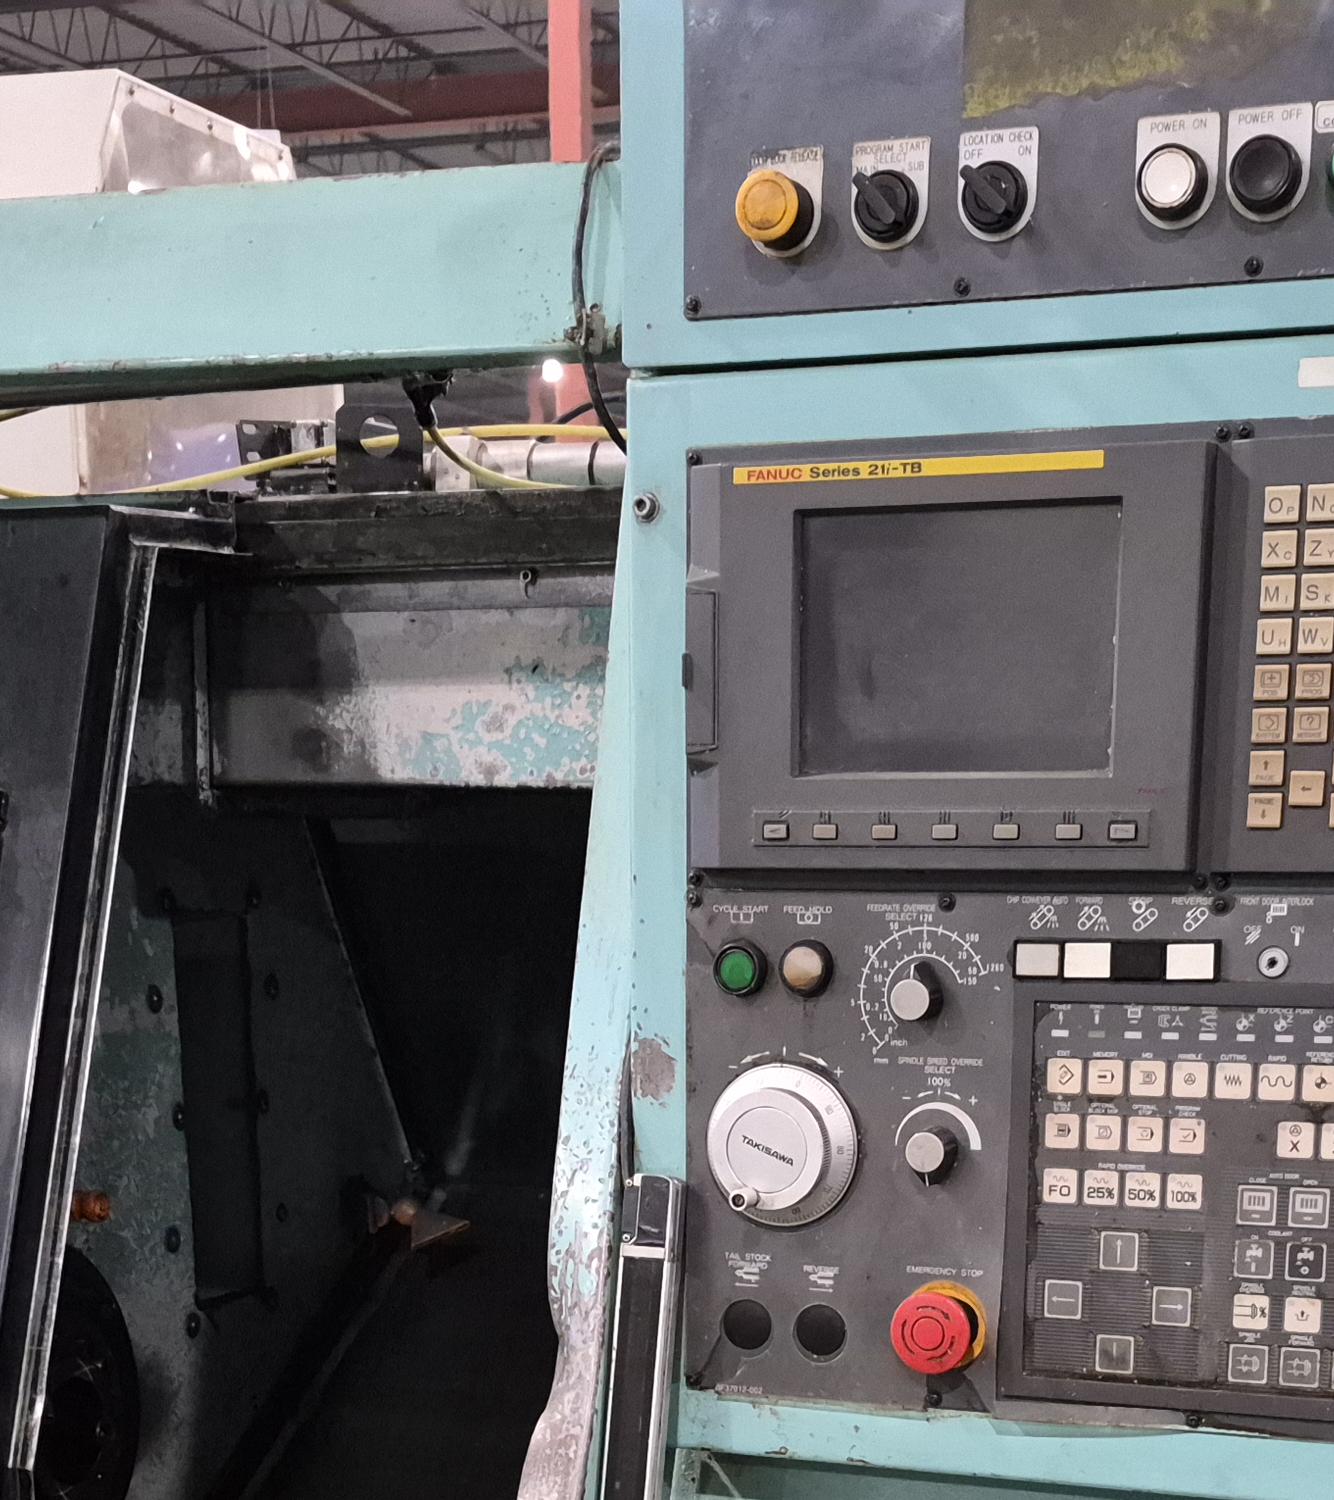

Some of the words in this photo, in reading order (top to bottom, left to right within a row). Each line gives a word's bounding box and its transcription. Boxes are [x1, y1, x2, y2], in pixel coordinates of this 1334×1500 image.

[1237, 110, 1274, 125] POWER
[1281, 108, 1303, 121] OFF
[1149, 120, 1186, 133] POWER
[1192, 118, 1208, 129] ON
[963, 131, 1004, 147] LOCATION
[1008, 130, 1035, 143] CHECK
[855, 141, 897, 157] PROGRAM
[898, 139, 927, 152] START
[963, 149, 984, 161] OFF
[1017, 145, 1032, 157] ON
[873, 152, 908, 164] SELECT
[907, 160, 925, 172] SUB
[746, 467, 804, 483] FANUC
[808, 464, 862, 479] Series
[867, 461, 923, 477] 21i-TB
[1311, 495, 1326, 512] N
[1266, 541, 1280, 559] X
[1309, 539, 1323, 557] Z
[1264, 585, 1280, 603] M
[1305, 584, 1319, 601] S
[1324, 594, 1332, 603] K
[1261, 628, 1275, 645] U
[1278, 637, 1287, 648] H
[1302, 628, 1319, 645] W
[867, 903, 901, 912] FEEDRATE
[1171, 896, 1214, 906] REVERSE
[713, 905, 740, 913] CYCLE
[742, 905, 769, 913] START
[783, 905, 805, 914] FEED
[807, 905, 833, 914] HOLD
[885, 912, 917, 921] SELECT
[1243, 925, 1262, 934] OFF
[1290, 925, 1305, 935] ON
[918, 941, 932, 950] 100
[890, 1039, 908, 1047] inch
[874, 1057, 889, 1065] mm
[924, 1066, 956, 1075] SELECT
[927, 1077, 951, 1088] 100%
[741, 1134, 795, 1167] TAKISAWA
[1289, 1140, 1301, 1153] X
[1086, 1186, 1115, 1200] 25%
[1127, 1188, 1157, 1202] 50%
[1170, 1190, 1198, 1204] 100%
[745, 1252, 772, 1262] STOCK
[906, 1265, 957, 1277] EMERGENCY
[960, 1267, 984, 1278] STOP
